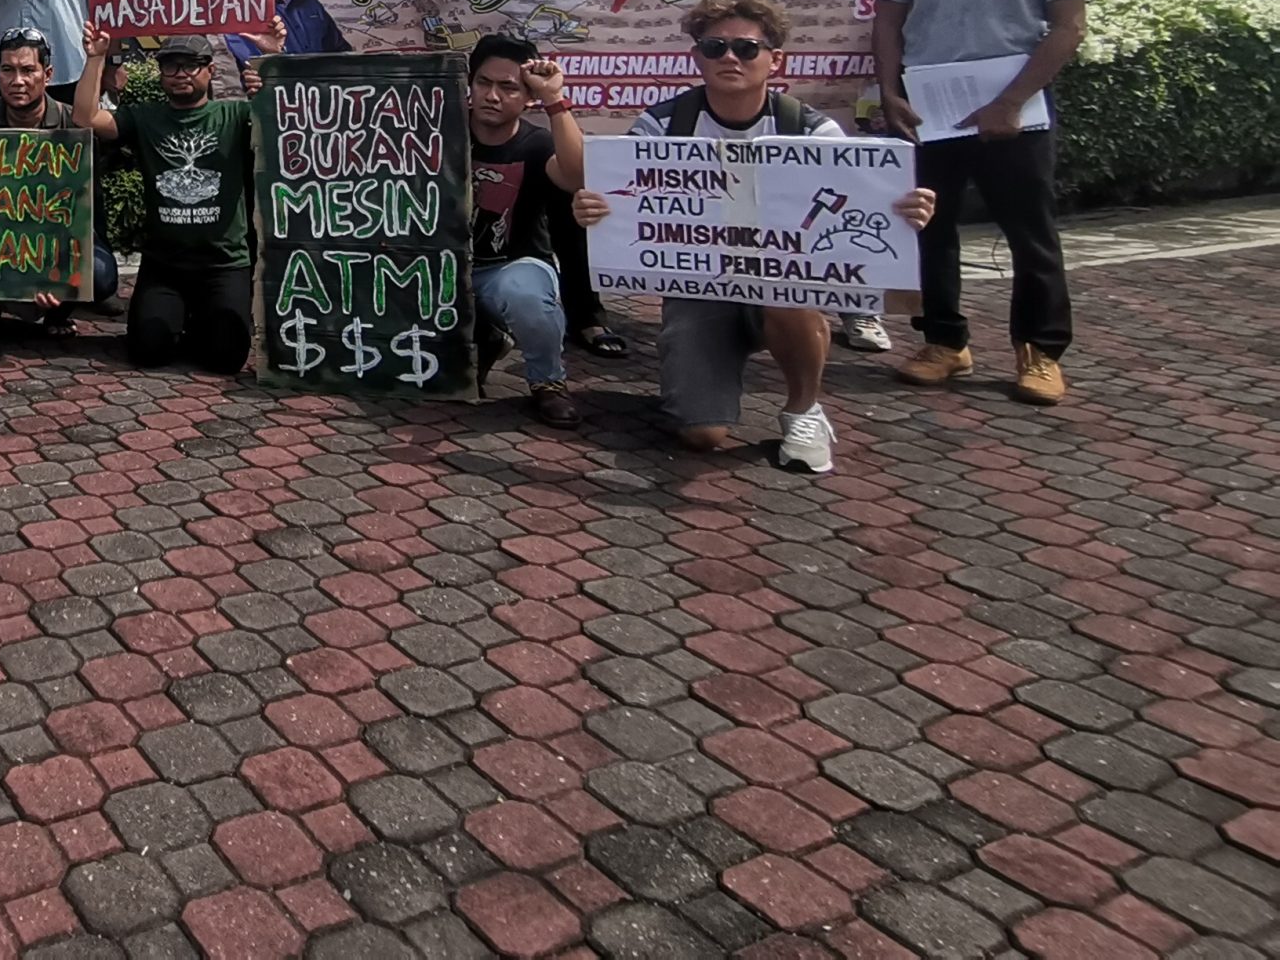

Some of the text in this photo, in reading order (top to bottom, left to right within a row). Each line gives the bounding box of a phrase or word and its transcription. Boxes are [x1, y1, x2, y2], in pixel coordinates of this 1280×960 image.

[785, 55, 875, 75] HEKTAR
[275, 82, 444, 132] HUTAN
[278, 130, 443, 179] BUKAN
[635, 142, 901, 168] HUTAN SIMPAN KITA
[635, 168, 728, 191] MISKIN
[271, 179, 439, 238] MESIN
[637, 197, 704, 216] ATAU
[639, 250, 867, 284] OLEH PEMBALAK
[276, 249, 457, 331] ATM!
[598, 274, 880, 310] DAN JABATAN HUTAN?
